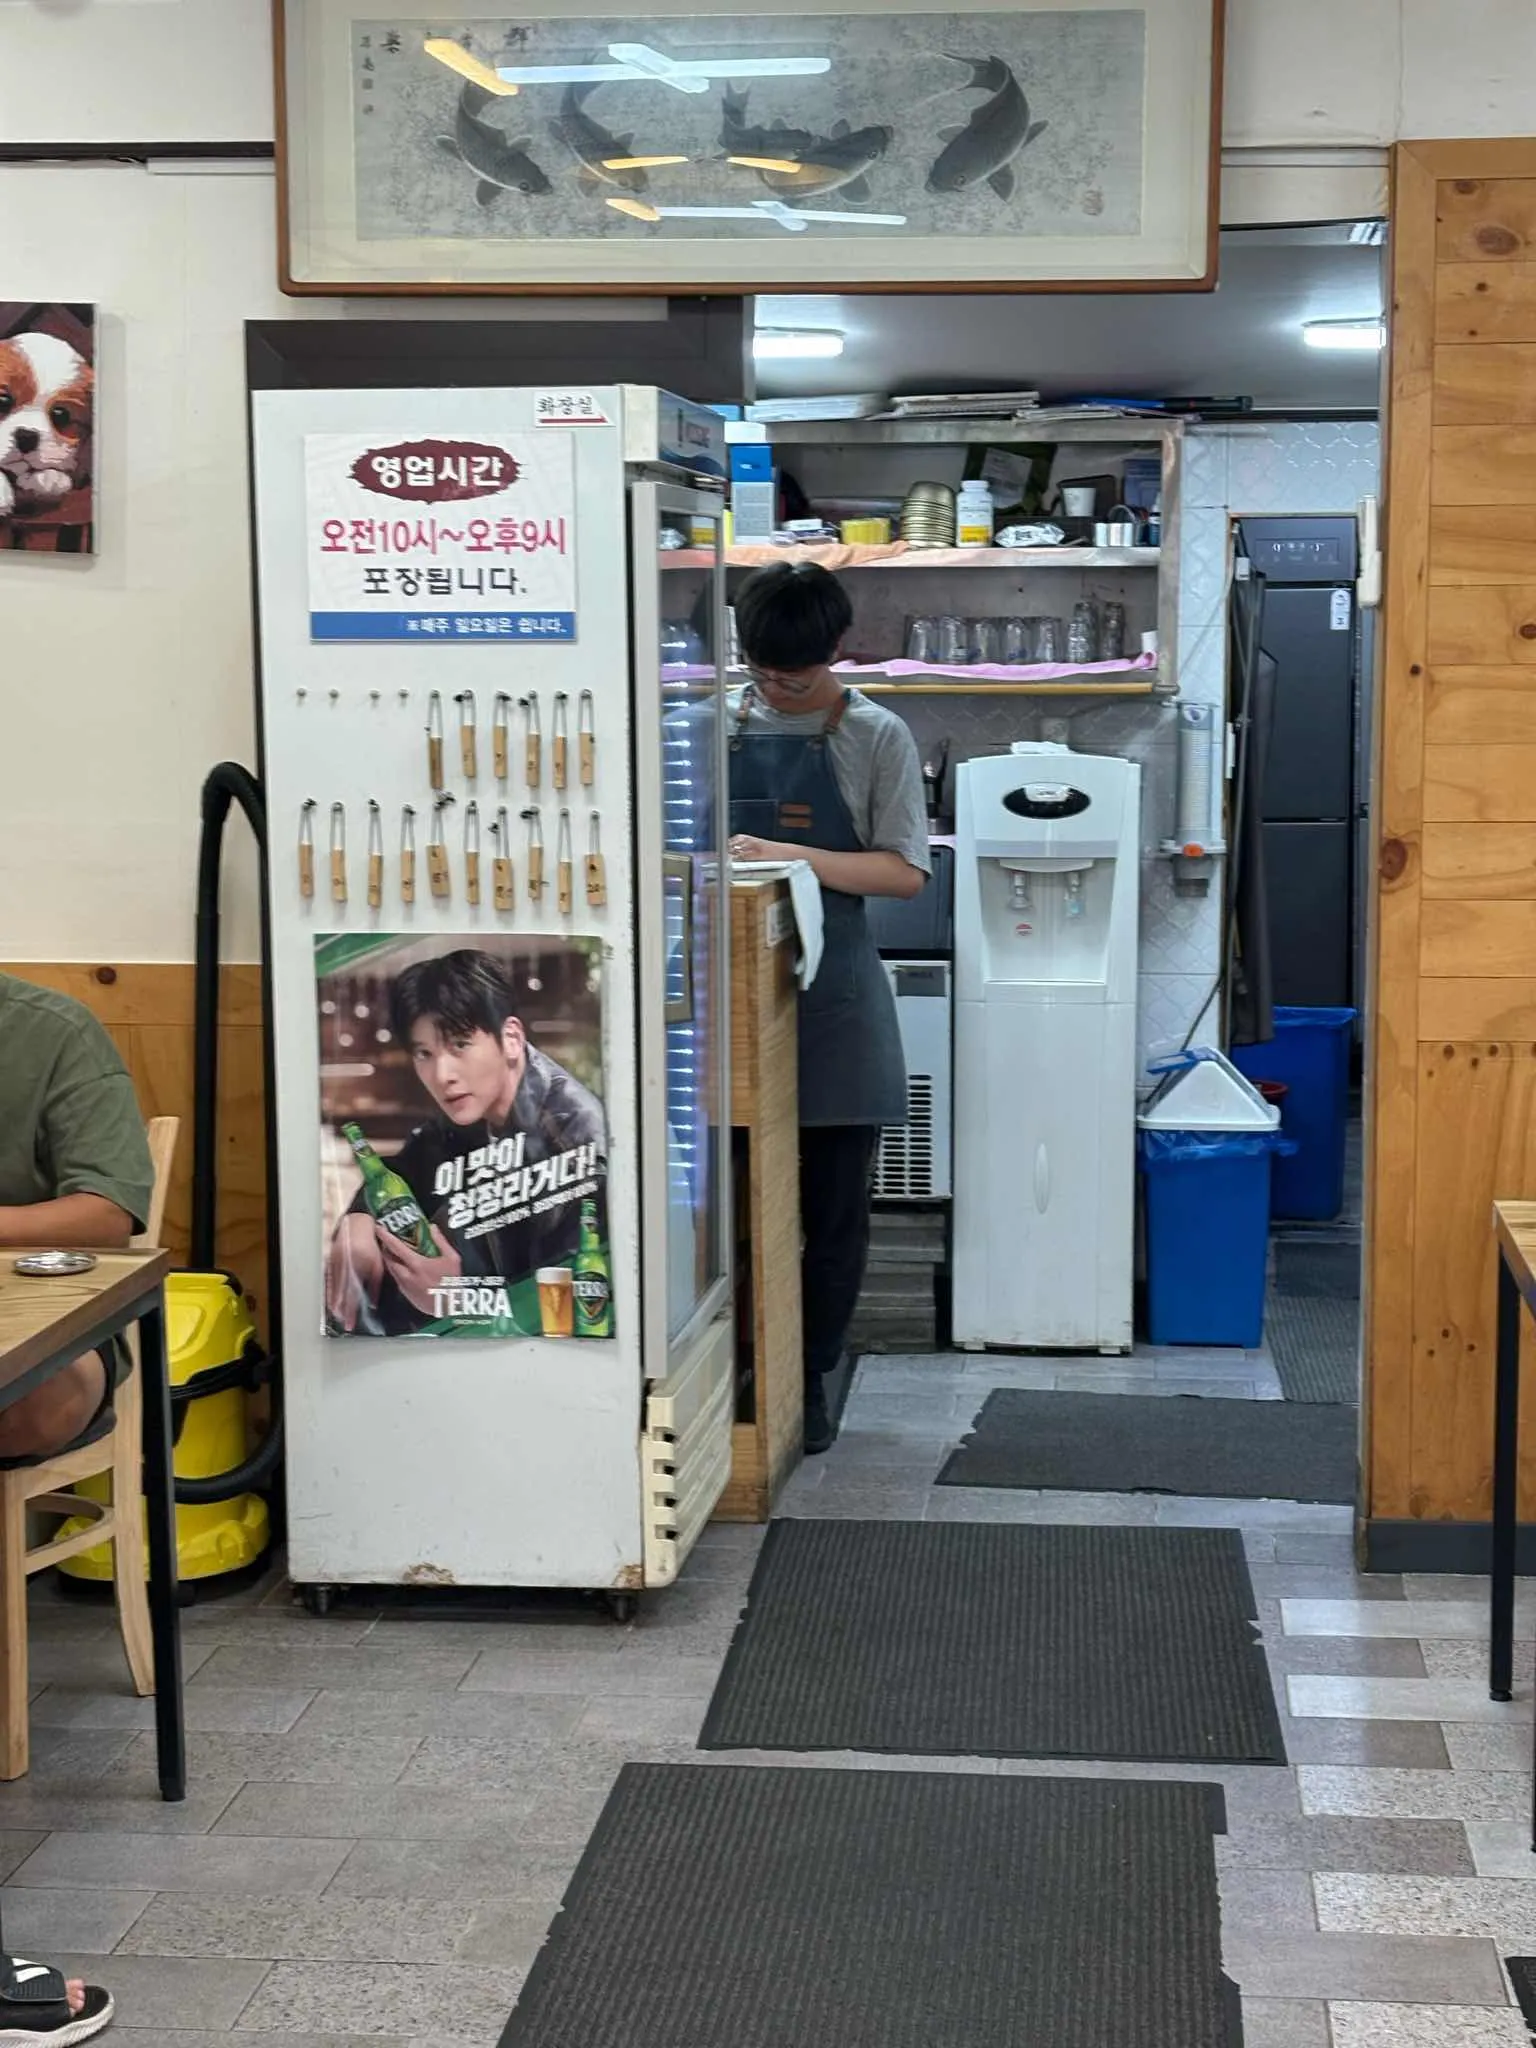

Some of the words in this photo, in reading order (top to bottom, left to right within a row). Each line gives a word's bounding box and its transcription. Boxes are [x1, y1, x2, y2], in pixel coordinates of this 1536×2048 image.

[536, 396, 594, 415] 화장실
[371, 456, 504, 488] 영업시간
[320, 517, 566, 554] 오전10시~오후9시
[363, 567, 527, 595] 포장됩니다.
[454, 617, 513, 633] 일요일은
[432, 1156, 465, 1196] 이
[465, 1132, 527, 1185] 맛이
[448, 1141, 597, 1229] 청정라거다!
[427, 1288, 513, 1318] TERRA
